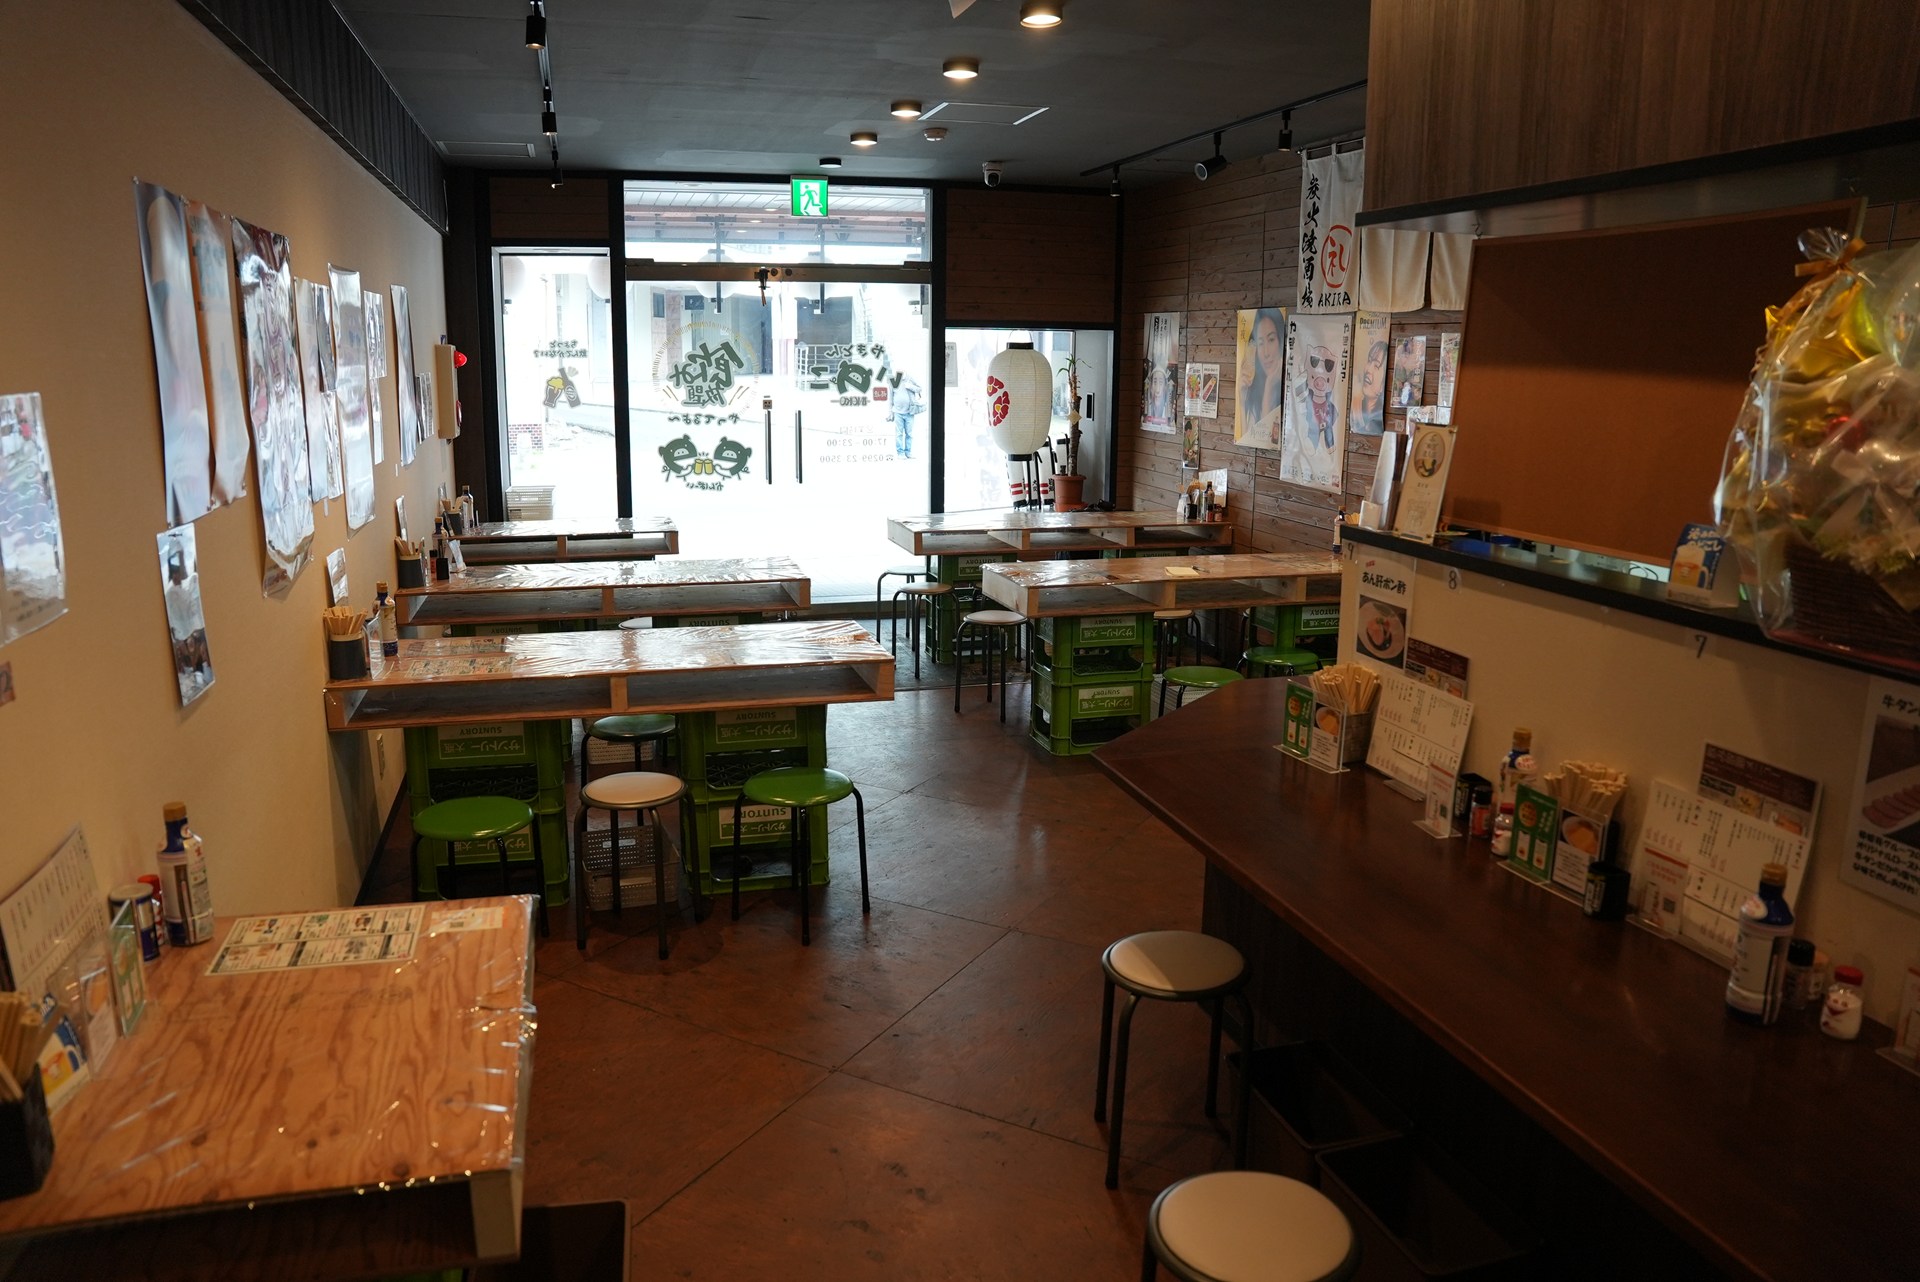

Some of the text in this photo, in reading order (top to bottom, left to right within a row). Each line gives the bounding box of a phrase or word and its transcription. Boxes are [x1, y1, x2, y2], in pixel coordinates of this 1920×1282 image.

[1318, 291, 1351, 307] AKIRA
[1362, 572, 1407, 595] あん肝ポン酢
[1448, 570, 1457, 590] 8
[1099, 628, 1133, 637] サントリー
[1695, 634, 1707, 658] 7
[1882, 694, 1920, 716] 牛タン
[735, 711, 777, 720] SUNTORY
[459, 726, 503, 735] SUNTORY
[745, 723, 793, 736] サントリー
[470, 739, 521, 752] サントリー
[751, 822, 786, 832] サントリー
[477, 838, 527, 850] サンリー
